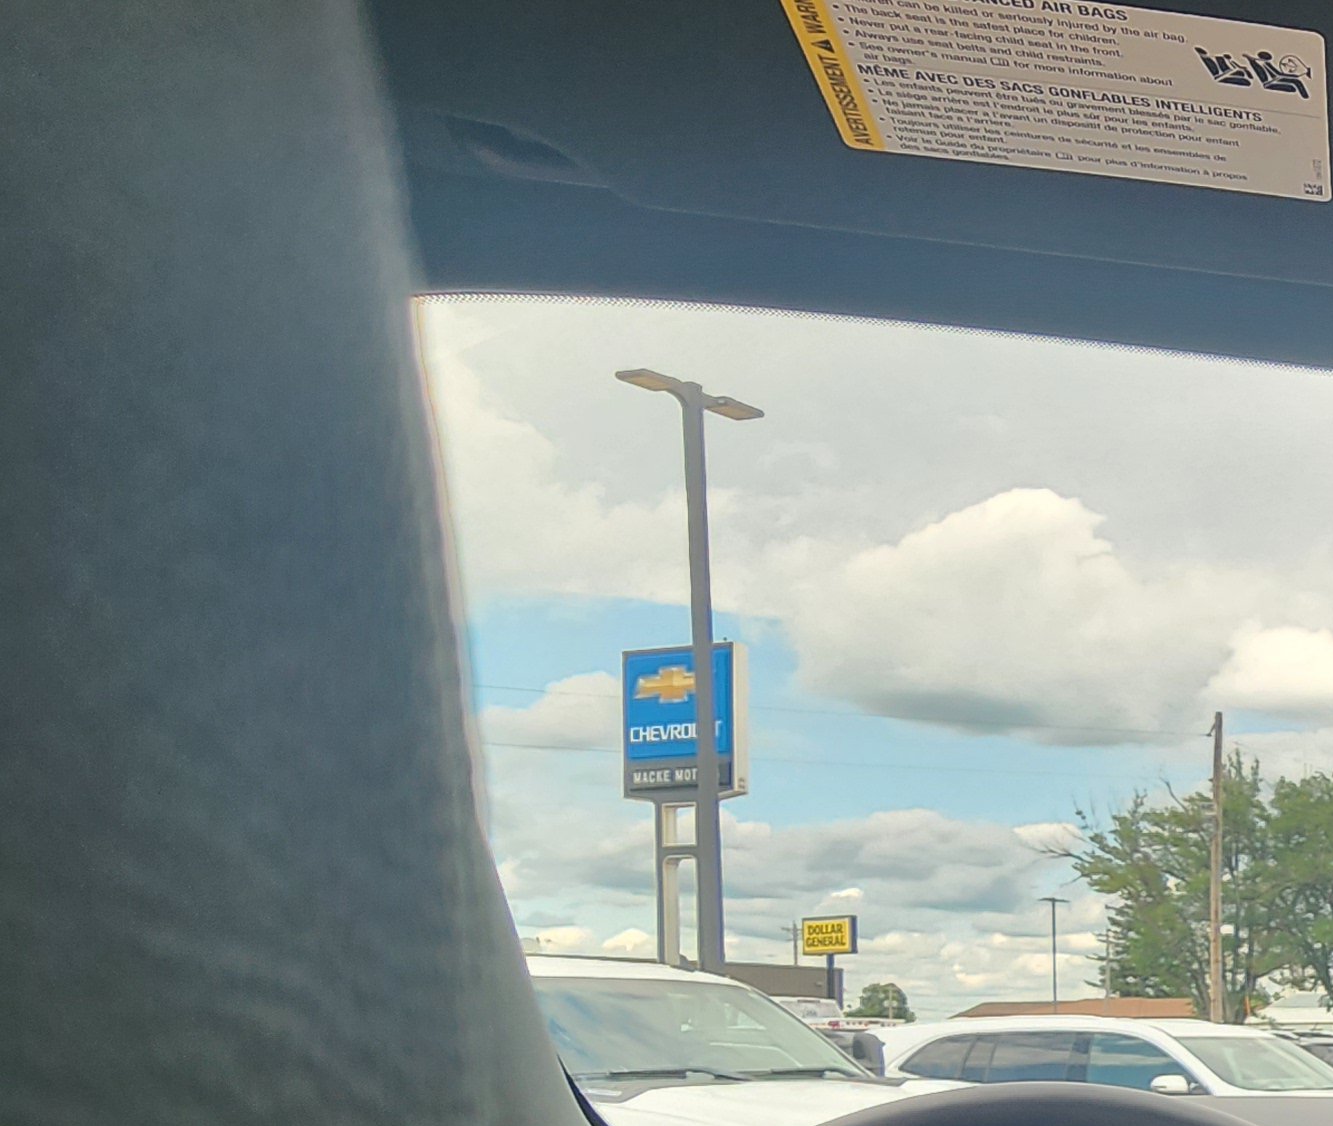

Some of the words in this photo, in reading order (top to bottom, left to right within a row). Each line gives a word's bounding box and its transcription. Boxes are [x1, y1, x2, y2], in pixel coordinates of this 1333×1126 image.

[843, 3, 868, 14] The
[870, 7, 902, 19] back
[903, 12, 932, 22] seat
[948, 17, 969, 27] the
[971, 20, 1011, 32] safest
[1012, 25, 1045, 37] place
[1048, 29, 1065, 39] for
[1067, 32, 1120, 46] children.
[922, 2, 940, 12] be
[942, 4, 979, 17] killed
[981, 10, 995, 18] or
[997, 11, 1053, 26] seriously
[1056, 18, 1099, 32] injured
[1101, 24, 1118, 35] by
[1120, 26, 1140, 36] the
[1142, 29, 1159, 39] air
[1041, 2, 1072, 14] AIR
[1077, 5, 1128, 21] BAGS
[848, 16, 886, 28] Never
[888, 21, 911, 33] put
[923, 26, 993, 42] rear-facing
[994, 34, 1025, 46] child
[1026, 39, 1053, 49] seat
[1069, 44, 1090, 54] the
[1092, 47, 1124, 58] front.
[853, 29, 900, 43] Always
[901, 36, 925, 45] use
[926, 39, 954, 49] seat
[955, 42, 987, 53] belts
[988, 46, 1012, 56] and
[1014, 49, 1044, 60] child
[1045, 53, 1106, 67] restraints.
[858, 41, 884, 52] See
[885, 44, 938, 58] owner's
[939, 52, 988, 65] manual
[1013, 60, 1030, 69] for
[1032, 64, 1065, 73] more
[1067, 66, 1136, 82] information
[1138, 75, 1173, 87] about
[862, 51, 879, 61] air
[816, 52, 874, 146] AVERTISSEMENT
[855, 61, 911, 80] MÊME
[912, 70, 960, 85] AVEC
[961, 76, 997, 90] DES
[999, 80, 1044, 95] SACS
[1047, 85, 1151, 108] GONFLABLES
[1154, 98, 1263, 122] INTELLIGENTS
[630, 720, 723, 742] CHEVROLT
[633, 769, 670, 785] MACKE
[806, 935, 846, 948] GENERAL
[807, 923, 843, 936] DOLLAR
